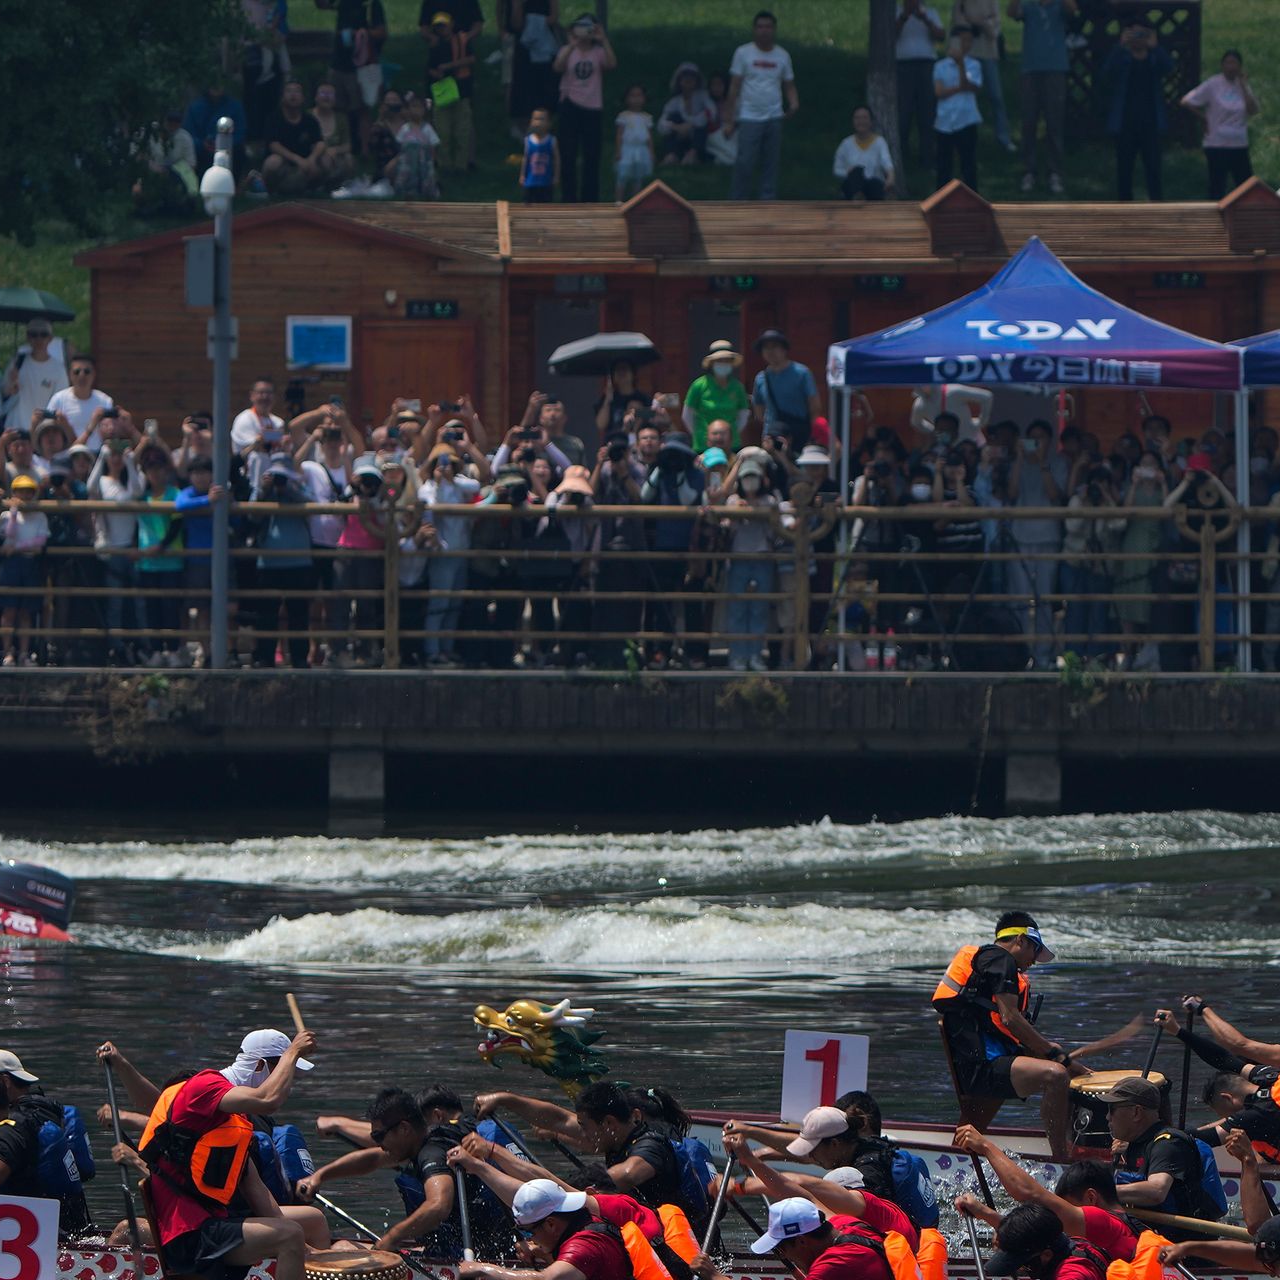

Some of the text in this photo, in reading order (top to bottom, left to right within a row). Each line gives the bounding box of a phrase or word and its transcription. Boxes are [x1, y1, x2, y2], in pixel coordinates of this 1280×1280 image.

[966, 319, 1117, 340] TODAY
[924, 353, 1162, 385] TODAY 今日体育
[37, 882, 67, 901] YAMAHA
[805, 1039, 840, 1107] 1
